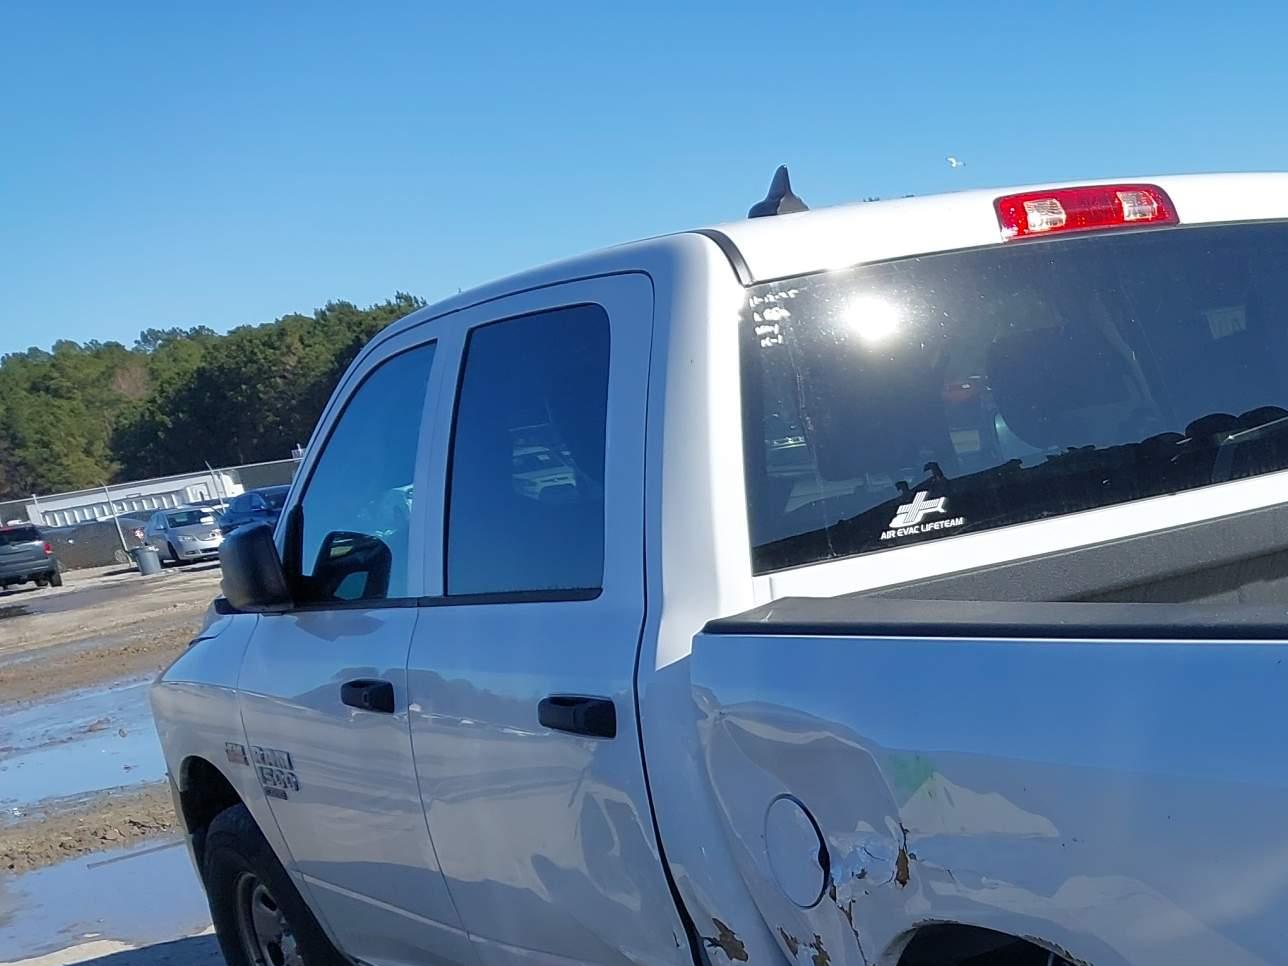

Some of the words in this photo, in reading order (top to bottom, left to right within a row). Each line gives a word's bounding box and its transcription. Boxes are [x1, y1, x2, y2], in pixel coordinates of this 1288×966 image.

[880, 530, 896, 541] AIR
[897, 525, 920, 537] EVAC
[920, 517, 965, 533] LIFETEAM
